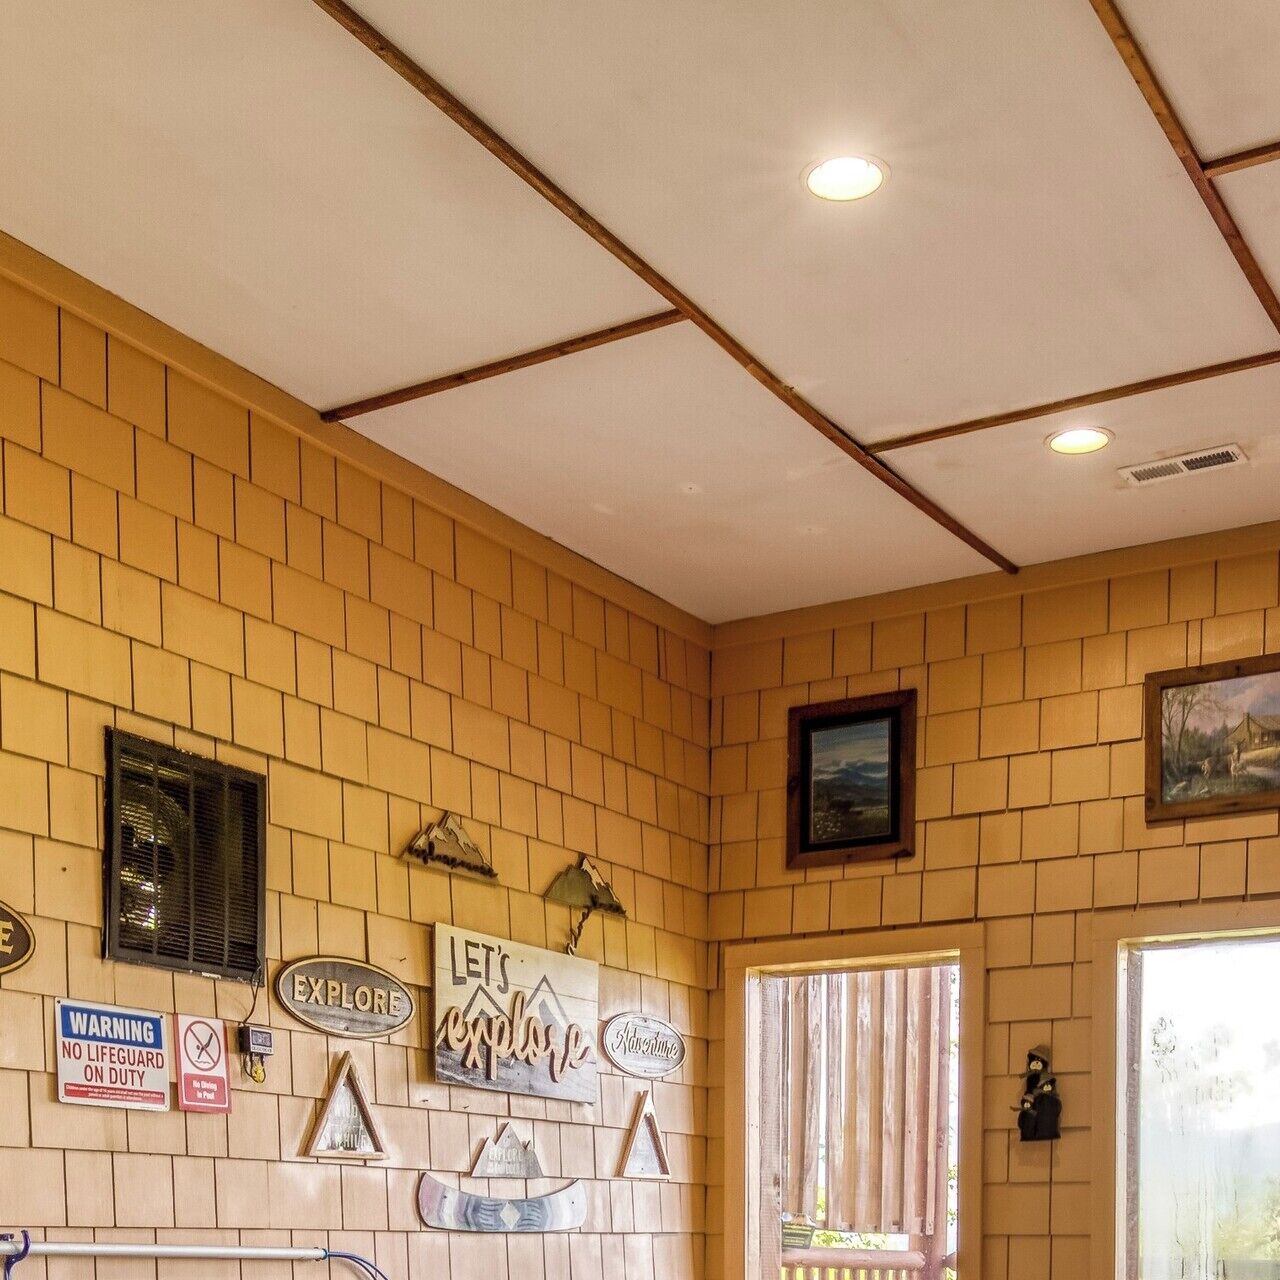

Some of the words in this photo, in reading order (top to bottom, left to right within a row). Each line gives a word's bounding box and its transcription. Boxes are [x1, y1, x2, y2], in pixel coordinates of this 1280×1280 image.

[450, 936, 510, 994] LET'S
[293, 974, 401, 1017] EXPLORE
[69, 1011, 154, 1044] WARNING
[447, 991, 590, 1083] explore
[611, 1021, 679, 1059] Adventure
[61, 1041, 82, 1060] NO
[87, 1043, 164, 1070] LIFEGUARD
[84, 1064, 106, 1083] ON
[109, 1068, 145, 1087] DUTY
